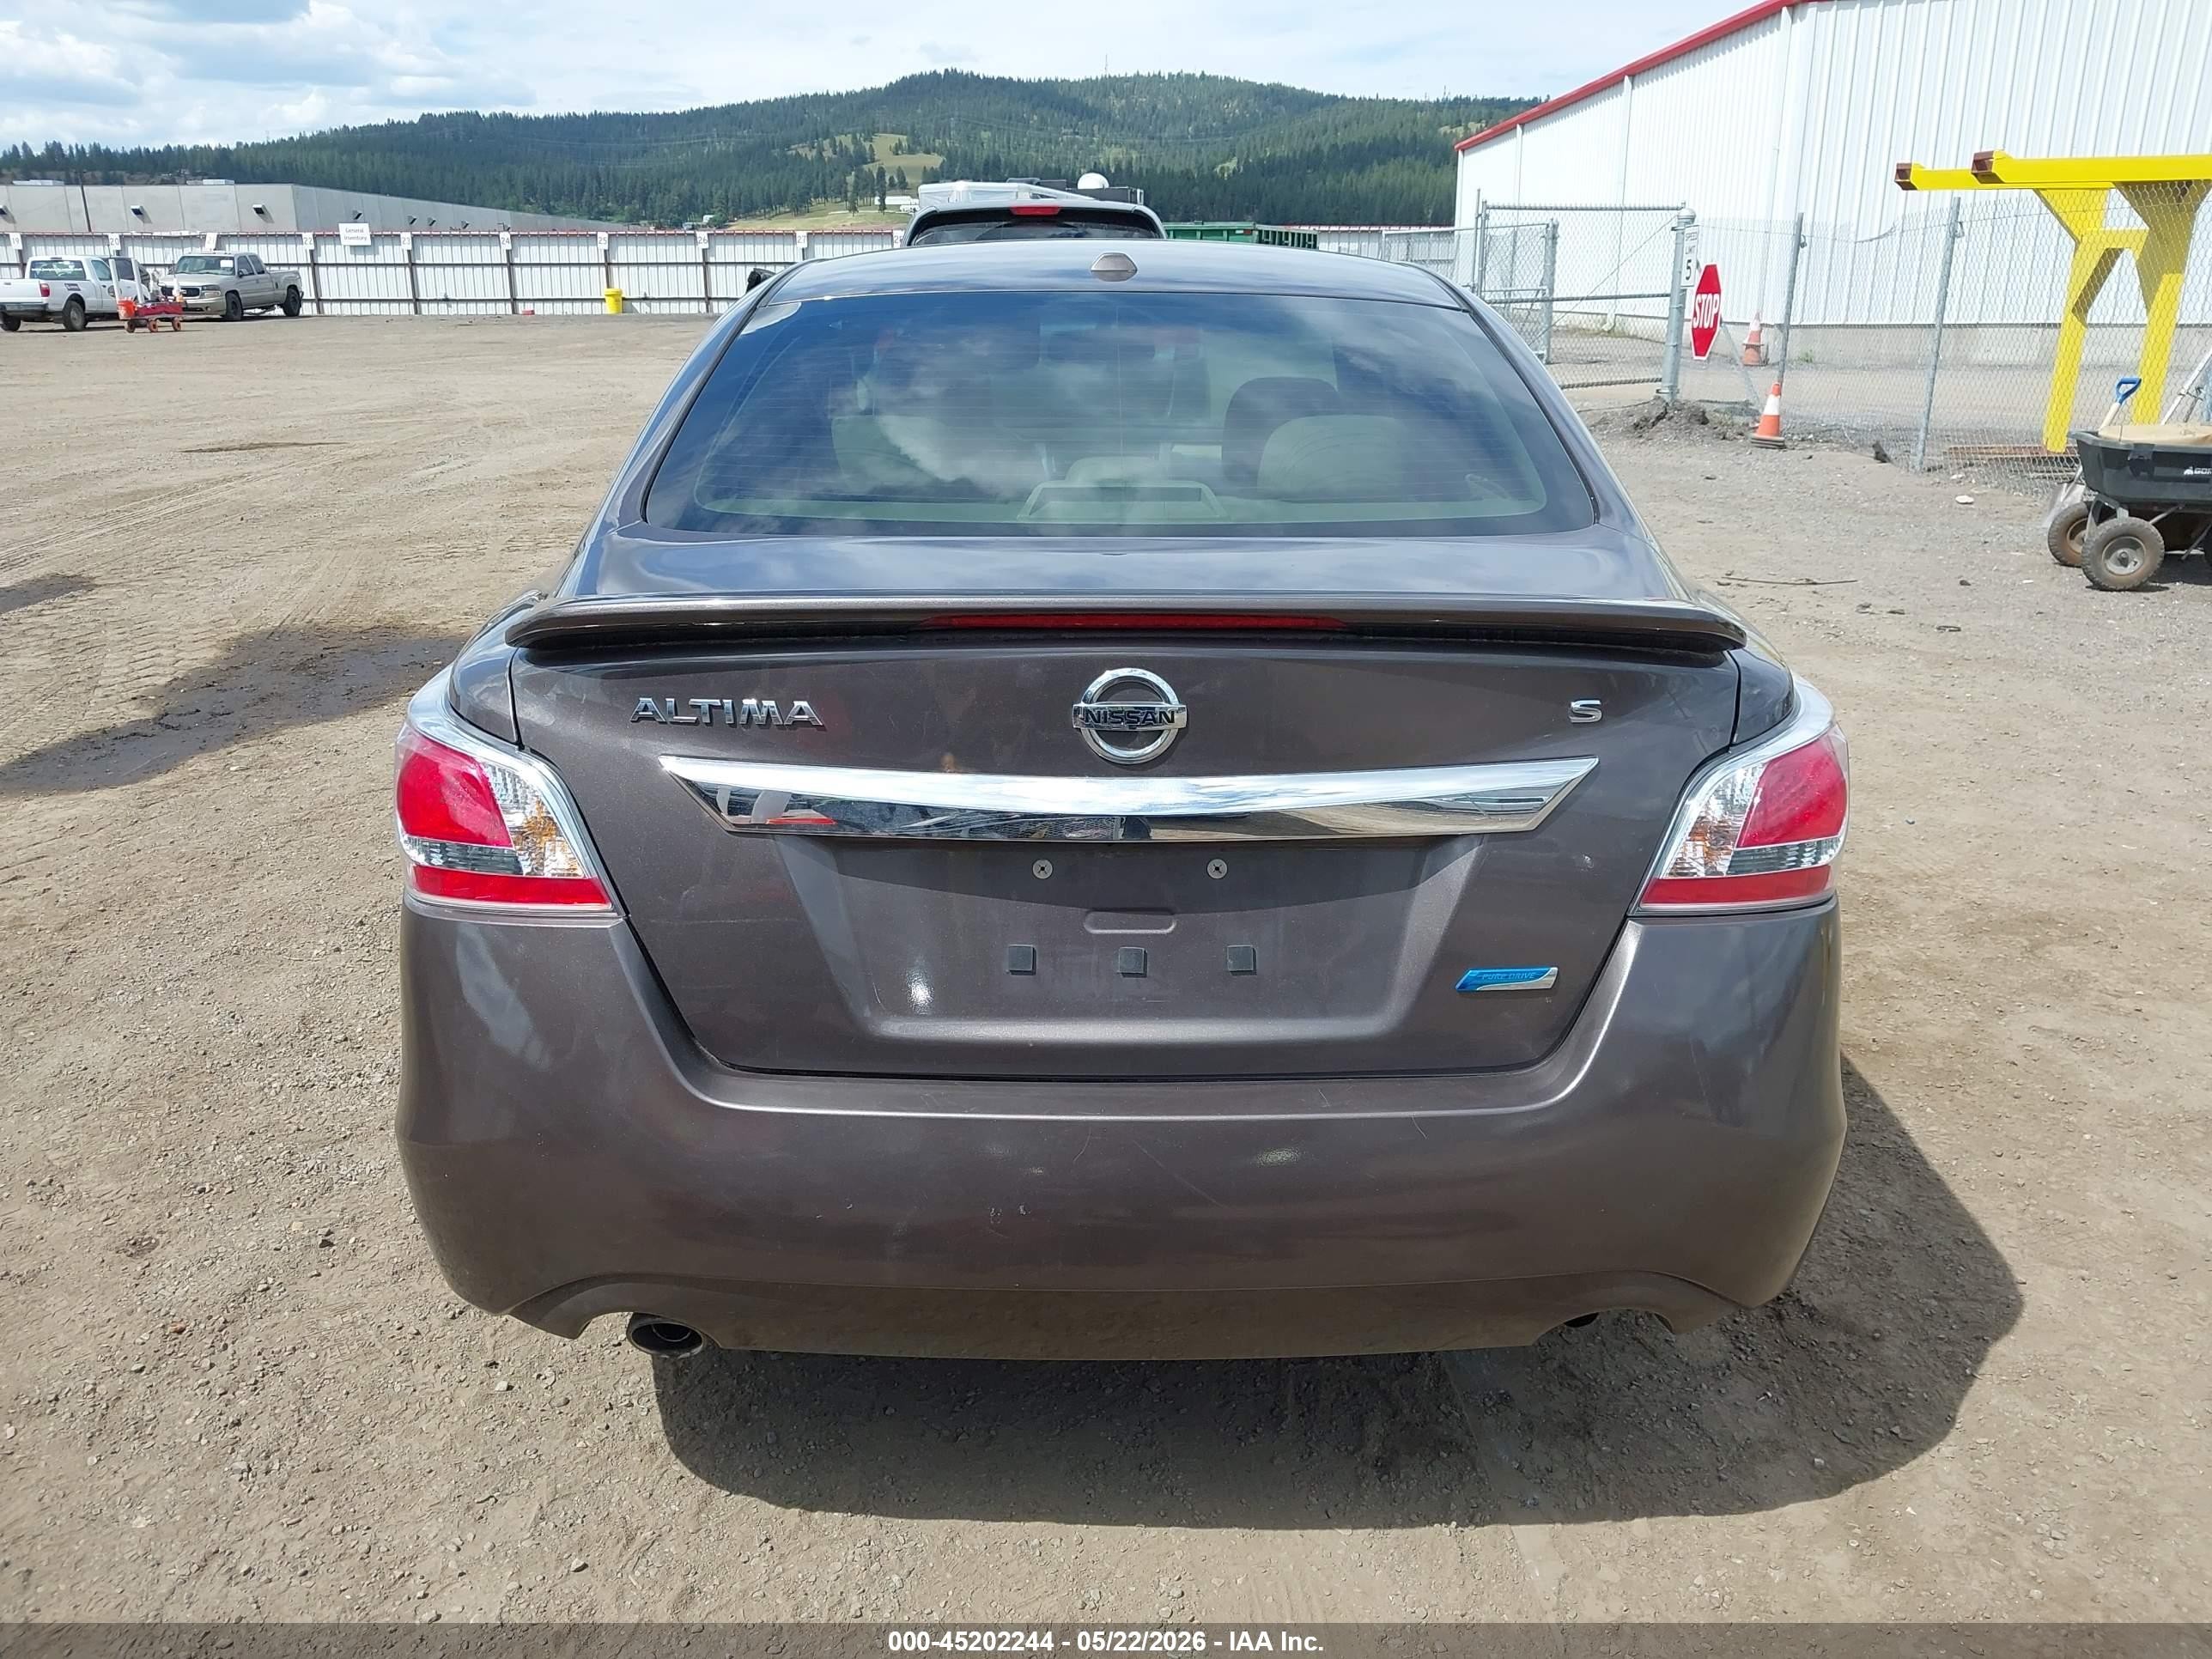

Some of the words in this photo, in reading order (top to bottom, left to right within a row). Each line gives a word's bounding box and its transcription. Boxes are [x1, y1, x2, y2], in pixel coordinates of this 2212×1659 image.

[12, 237, 20, 246] 19
[110, 237, 119, 246] 20
[304, 237, 313, 246] 22
[599, 236, 607, 245] 25
[1686, 258, 1692, 281] 5
[1692, 293, 1719, 329] STOP
[630, 696, 824, 726] ALTIMA
[1085, 710, 1175, 724] NISSAN
[1568, 699, 1602, 723] S
